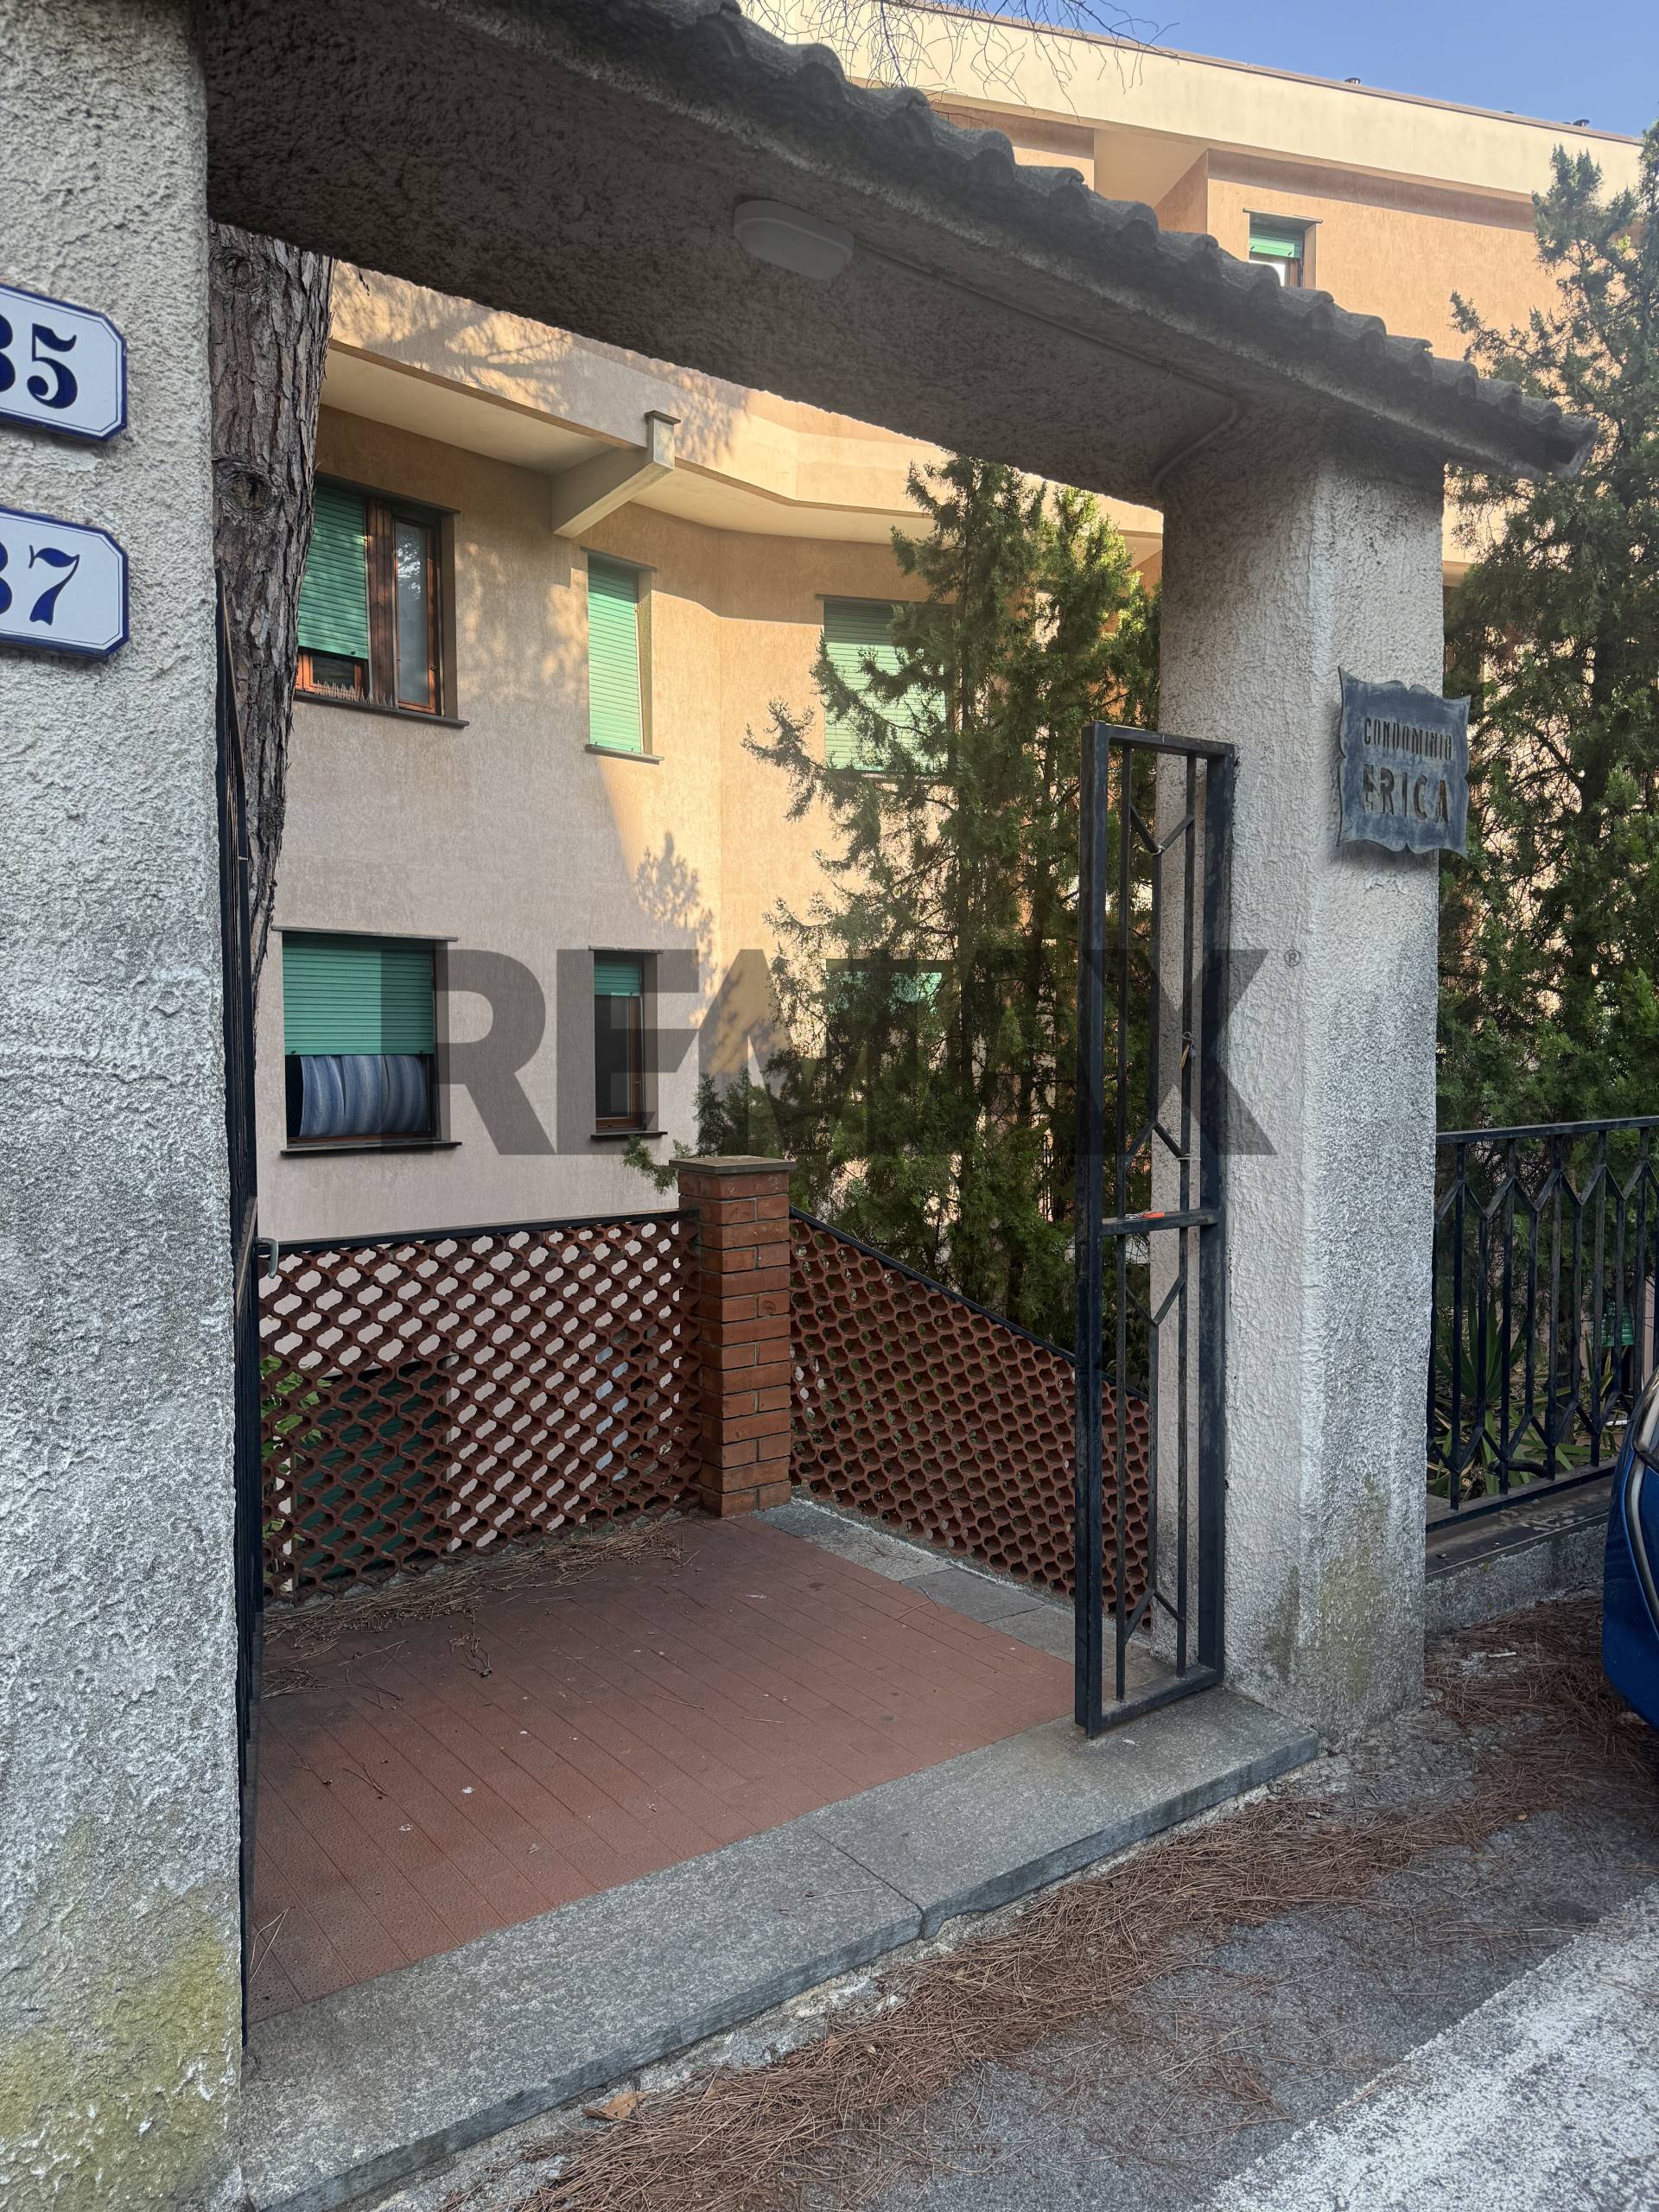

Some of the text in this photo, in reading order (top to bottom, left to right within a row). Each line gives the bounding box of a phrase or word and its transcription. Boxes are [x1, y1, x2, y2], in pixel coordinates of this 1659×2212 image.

[0, 543, 79, 626] 7
[1363, 716, 1452, 761] CONDOMINIO
[1363, 764, 1450, 824] ERICA
